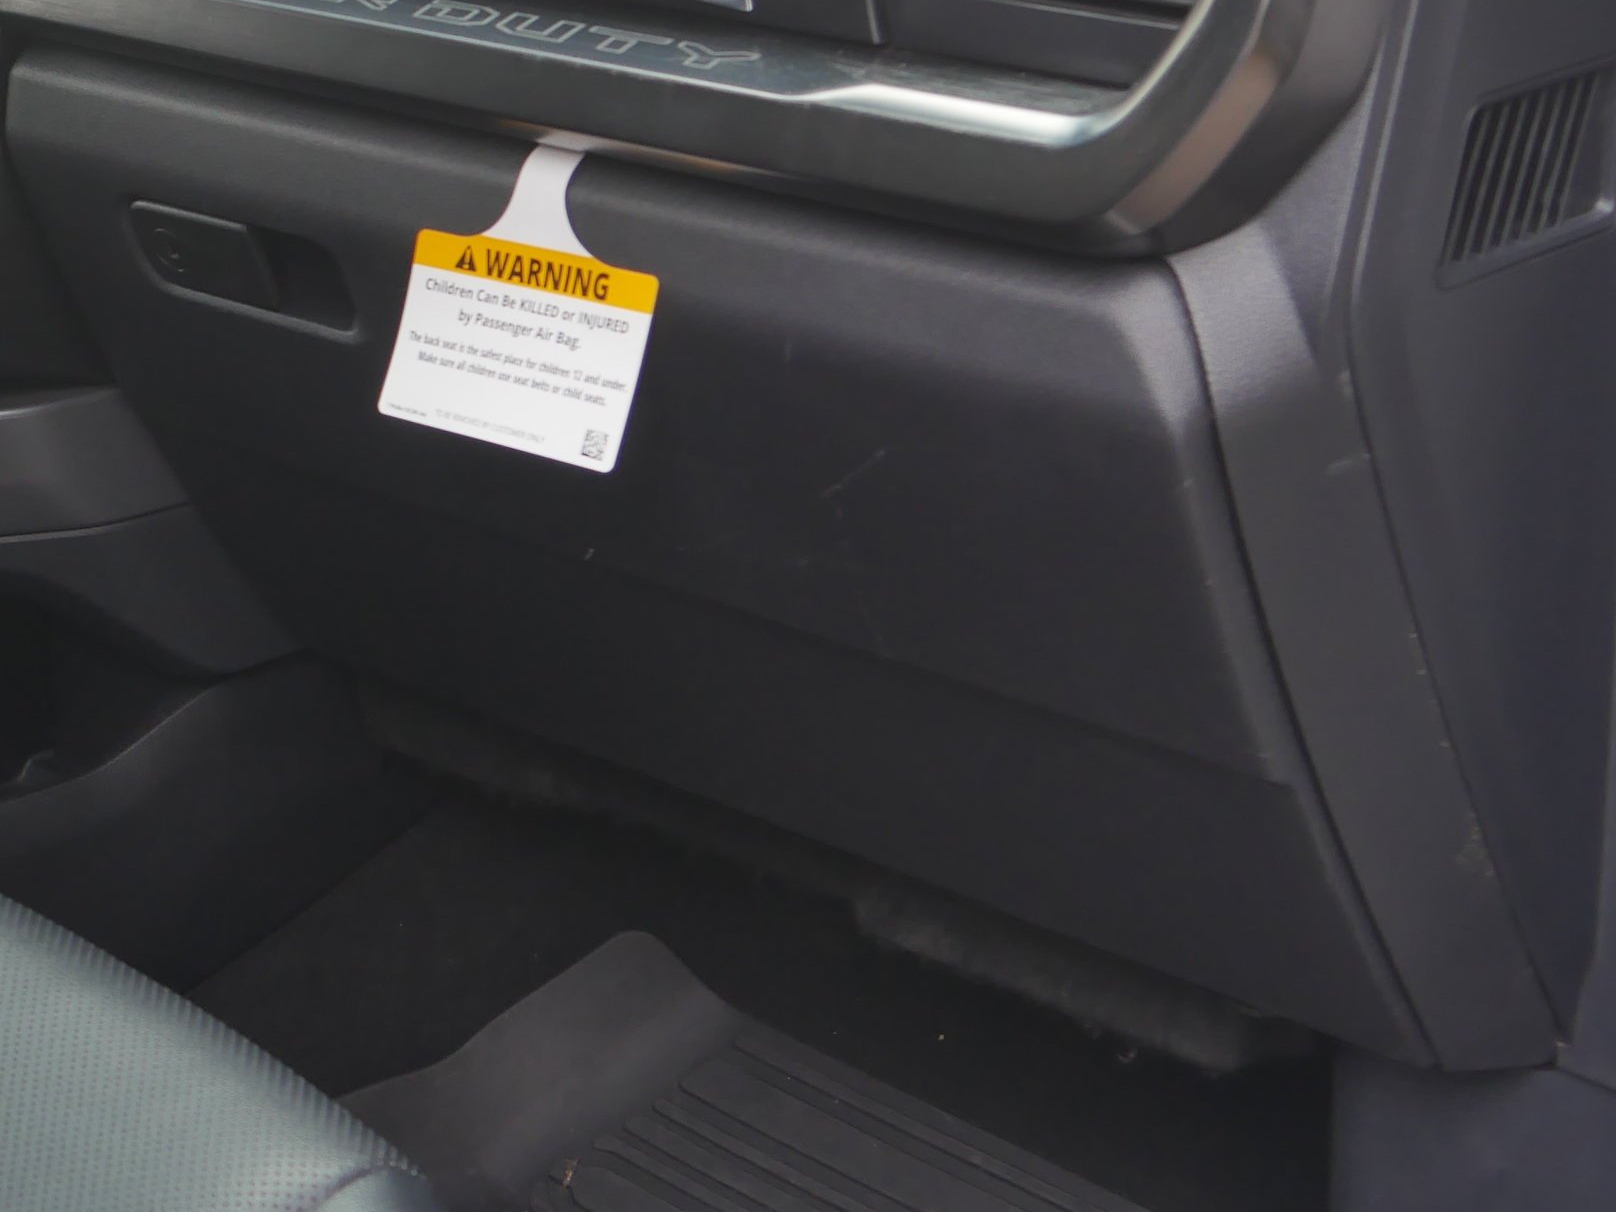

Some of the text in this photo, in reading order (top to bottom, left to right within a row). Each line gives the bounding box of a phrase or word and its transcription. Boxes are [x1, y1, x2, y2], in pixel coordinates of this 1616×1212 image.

[486, 248, 611, 300] WARNING
[425, 277, 630, 334] Children Can Be KILLED or INJURED
[458, 308, 472, 326] by
[475, 312, 533, 338] Passenger
[535, 327, 554, 341] Air
[409, 330, 423, 342] The
[423, 333, 440, 347] back
[442, 338, 458, 350] seat
[466, 345, 479, 356] the
[480, 348, 503, 362] safest
[503, 354, 524, 366] place
[525, 358, 537, 369] for
[538, 362, 570, 378] children
[584, 374, 601, 386] and
[418, 350, 438, 365] Make
[439, 357, 455, 367] sure
[456, 359, 467, 371] all
[466, 363, 497, 378] children
[512, 374, 530, 387] seat
[531, 379, 550, 392] belts
[562, 386, 583, 400] child
